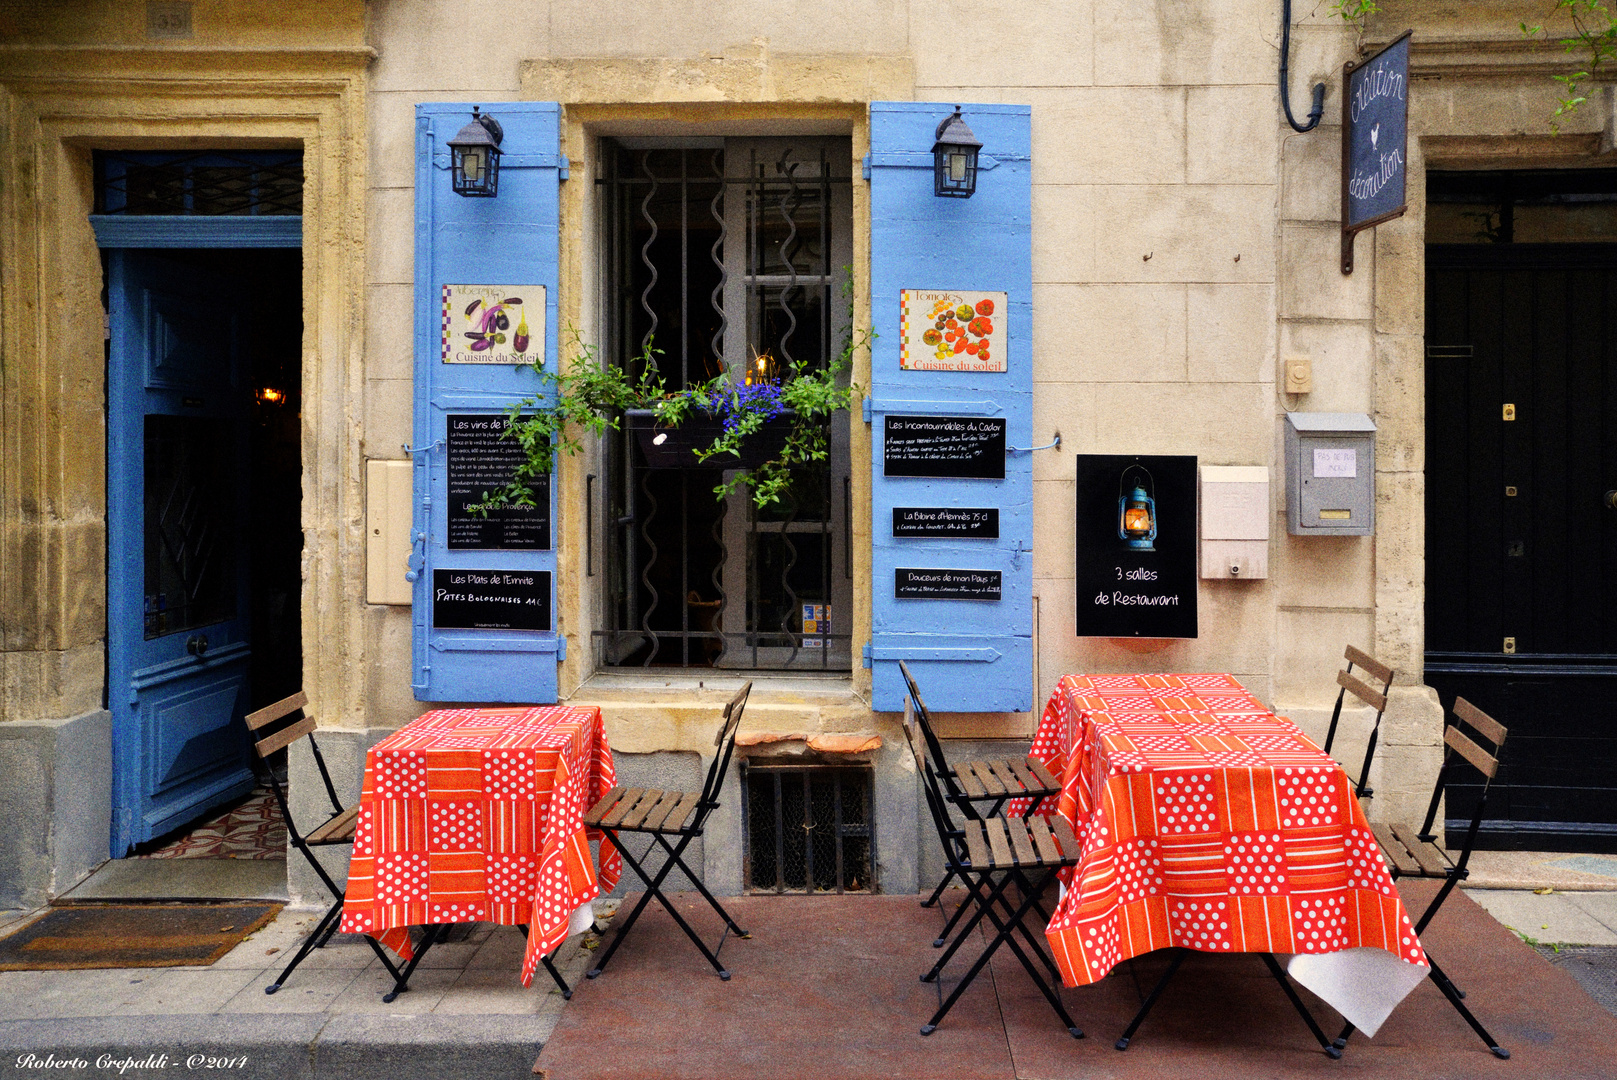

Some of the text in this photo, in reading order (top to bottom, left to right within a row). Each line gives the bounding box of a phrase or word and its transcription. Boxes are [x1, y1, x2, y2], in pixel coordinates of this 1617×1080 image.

[1350, 148, 1403, 200] décoration
[456, 352, 494, 362] Cuisine
[495, 353, 508, 362] du
[913, 360, 1001, 372] Cuisine du soleil
[453, 419, 469, 430] Les
[470, 420, 488, 430] vins
[490, 419, 501, 430] de
[888, 420, 1001, 432] Les Incontournables du Cador
[903, 512, 914, 520] La
[972, 513, 980, 521] 75
[450, 574, 466, 584] Les
[467, 574, 489, 585] Plats
[489, 574, 501, 585] de
[908, 572, 941, 582] Douceurs
[942, 573, 952, 582] de
[971, 574, 989, 584] Pays
[1115, 566, 1158, 581] 3 salles
[1094, 590, 1179, 606] de Restaurant
